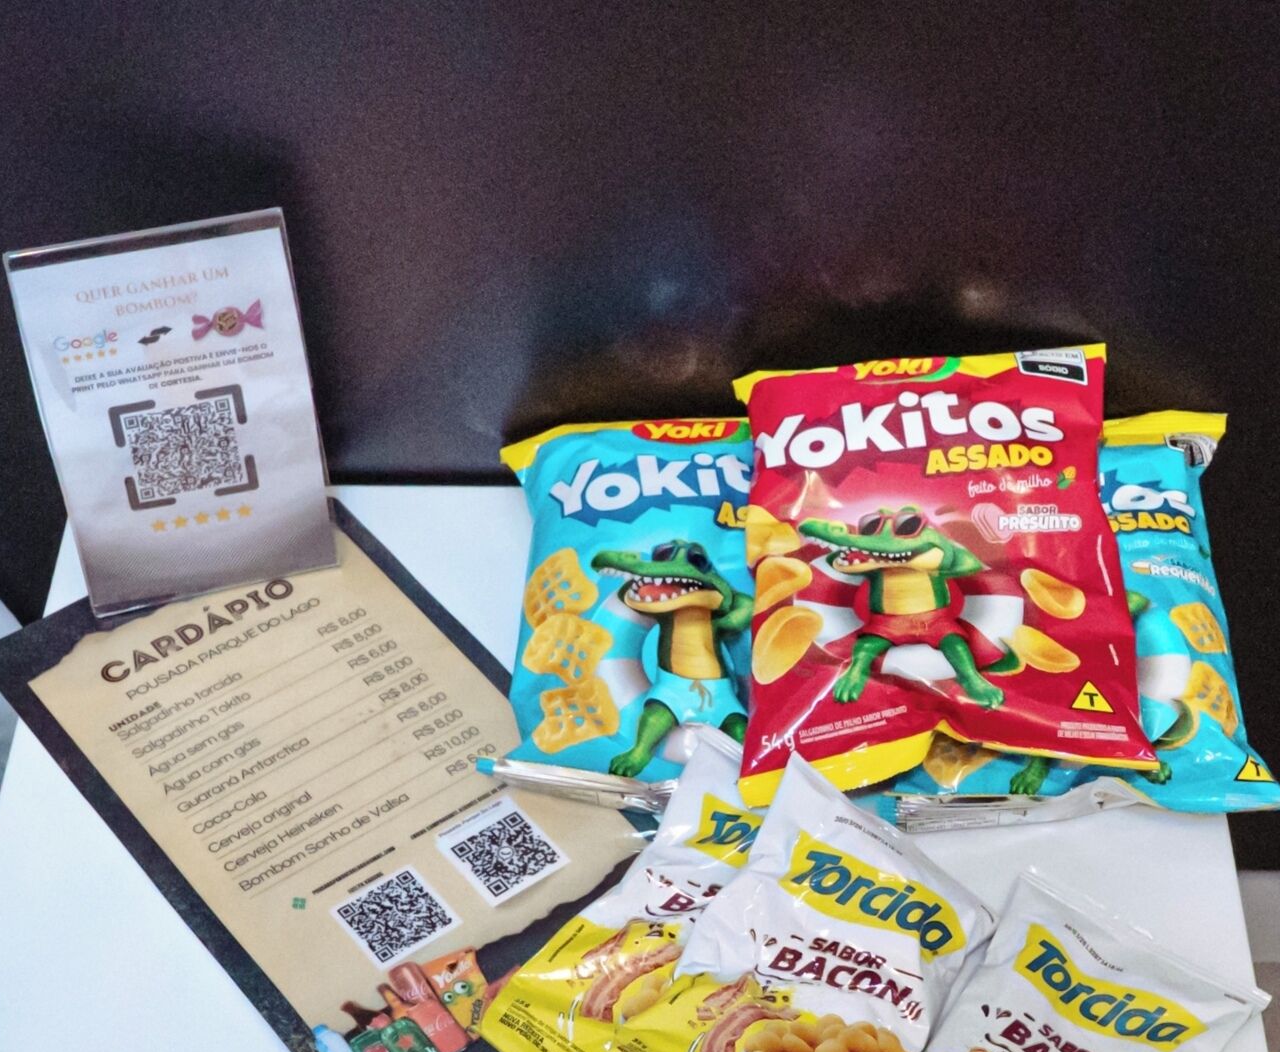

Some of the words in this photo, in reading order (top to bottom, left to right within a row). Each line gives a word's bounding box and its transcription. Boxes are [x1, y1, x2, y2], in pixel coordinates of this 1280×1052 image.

[75, 286, 120, 302] QUER
[126, 271, 198, 296] GANHAR
[203, 266, 229, 280] UM
[116, 292, 197, 317] BOMBOM?
[53, 329, 118, 350] Google
[852, 358, 933, 381] Yoki
[643, 422, 727, 439] Yoki
[756, 390, 1064, 468] Yokitos
[925, 443, 1053, 476] ASSADO
[550, 453, 751, 516] Yokit
[968, 480, 996, 497] feito
[1016, 473, 1052, 491] milho
[1019, 505, 1056, 514] SABOR
[1107, 512, 1190, 533] SSADO
[101, 578, 293, 682] CARDÁPIO
[126, 658, 200, 700] POUSADA
[198, 628, 259, 664] PARQUE
[257, 616, 281, 633] DO
[280, 597, 319, 623] LAGO
[108, 701, 162, 733] UNIDADE
[117, 697, 195, 742] Salgadinho
[317, 622, 338, 637] R$
[132, 713, 209, 760] Salgadinho
[332, 638, 354, 653] R$
[148, 752, 186, 777] Água
[188, 734, 218, 755] sem
[218, 721, 244, 741] gás
[347, 653, 370, 669] R$
[1083, 692, 1098, 707] T
[163, 770, 201, 796] Água
[202, 752, 235, 774] com
[234, 737, 261, 758] gás
[363, 670, 385, 687] R$
[177, 774, 240, 813] Guaraná
[241, 736, 309, 780] Antarctica
[379, 687, 401, 704] R$
[193, 790, 267, 835] Coca-Cola
[397, 706, 419, 723] R$
[208, 820, 263, 853] Cerveja
[263, 790, 312, 824] original
[412, 724, 435, 741] R$
[224, 840, 279, 873] Cerveja
[277, 803, 343, 843] Heineken
[423, 744, 446, 761] R$
[239, 850, 306, 892] Bombom
[305, 825, 351, 855] Sonho
[351, 812, 370, 830] de
[369, 792, 410, 818] Valsa
[445, 759, 468, 776] R$
[791, 850, 953, 952] Torcida
[768, 946, 913, 1008] BACON
[809, 937, 887, 970] SABOR
[1026, 939, 1190, 1044] Torcida
